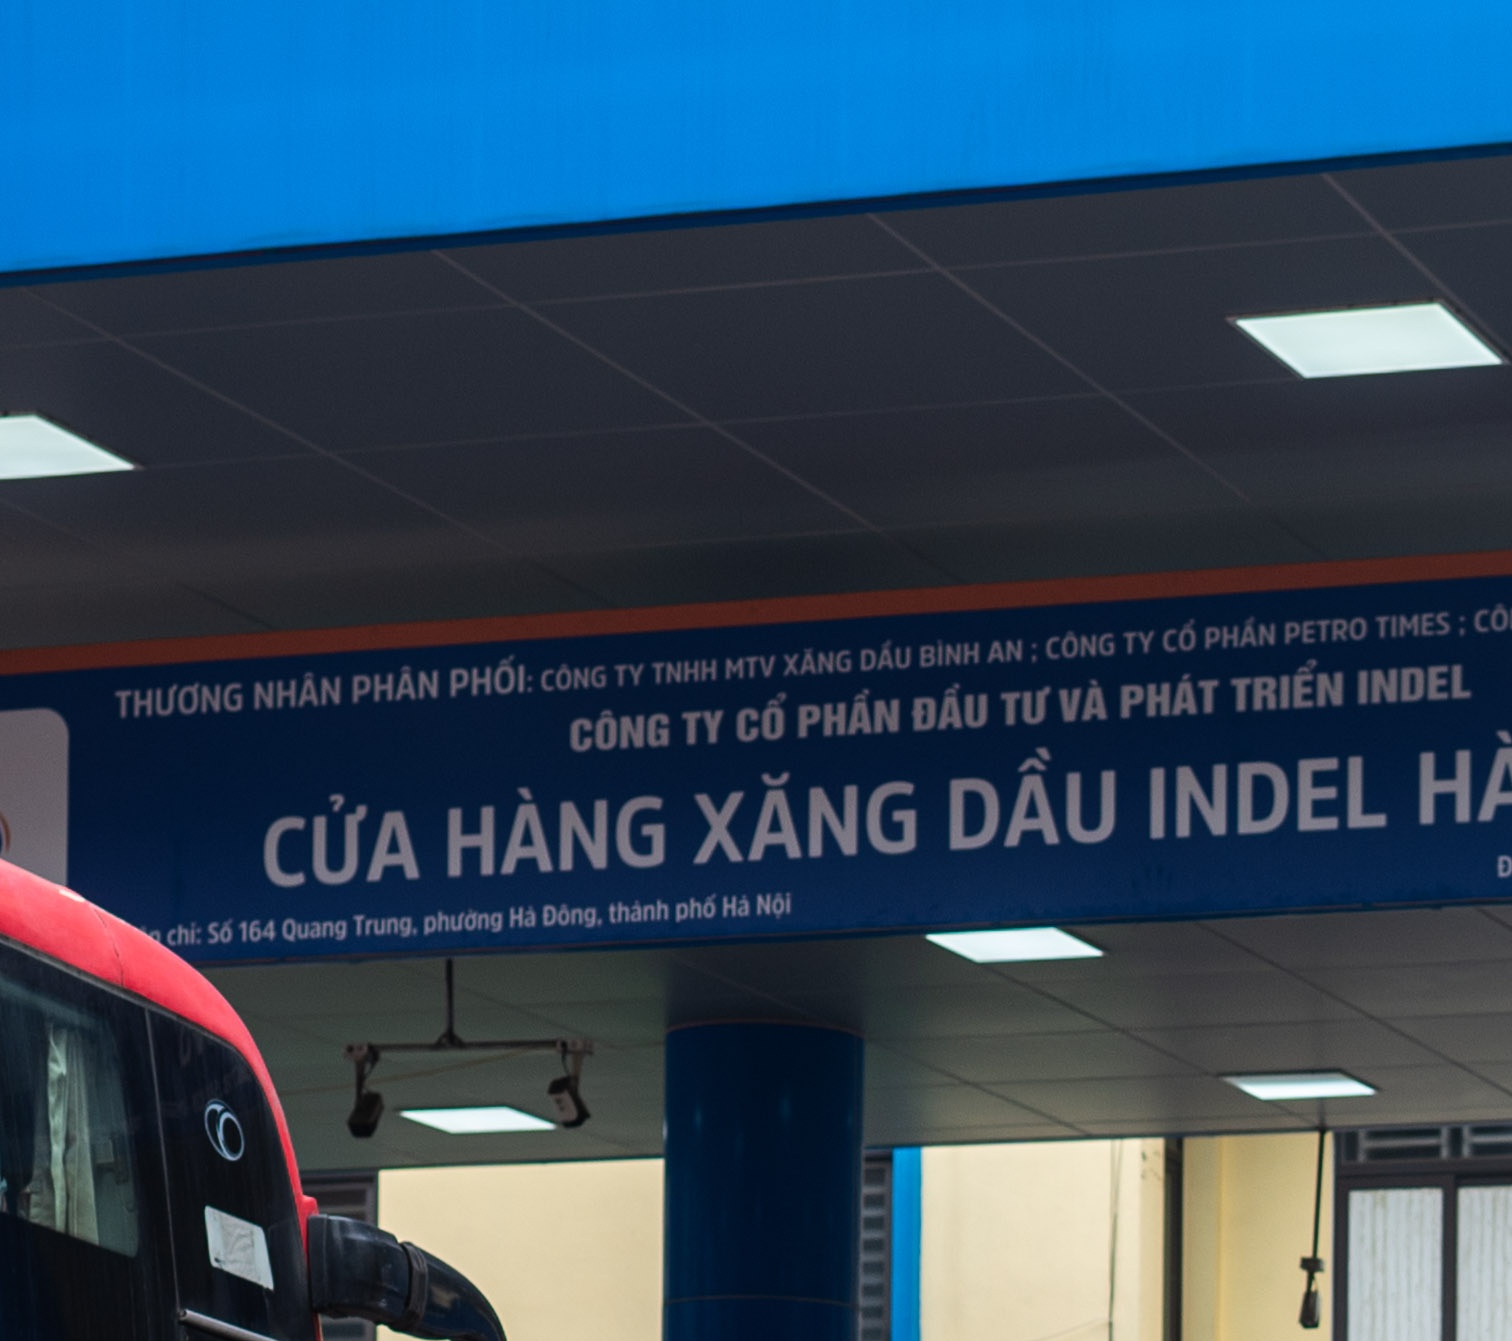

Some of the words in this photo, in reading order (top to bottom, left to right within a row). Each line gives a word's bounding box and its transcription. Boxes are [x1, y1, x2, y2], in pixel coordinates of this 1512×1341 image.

[115, 683, 243, 718] THƯƠNG
[254, 673, 341, 710] NHÂN
[352, 667, 439, 704] PHÂN
[450, 656, 532, 697] PHỐI:
[541, 664, 607, 691] CÔNG
[614, 664, 644, 687] TY
[652, 659, 717, 684] TNHH
[725, 655, 775, 680] MTV
[784, 649, 852, 676] XĂNG
[920, 639, 979, 668] BÌNH
[987, 640, 1023, 663] AN
[1046, 631, 1115, 659] CÔNG
[1123, 630, 1154, 654] TY
[1285, 617, 1368, 644] PETRO
[1376, 612, 1450, 638] TIMES
[570, 705, 670, 752] CÔNG
[682, 710, 724, 745] TY
[736, 692, 786, 742] CỔ
[798, 689, 900, 738] PHẦN
[912, 683, 988, 731] ĐẦU
[1000, 686, 1051, 726] TƯ
[1059, 679, 1108, 722] VÀ
[1120, 674, 1220, 719] PHÁT
[1230, 659, 1344, 712] TRIỂN
[1358, 664, 1472, 705] INDEL
[264, 794, 420, 888] CỬA
[447, 787, 665, 878] HÀNG
[693, 772, 917, 864] XĂNG
[949, 747, 1116, 850] DẦU
[1150, 755, 1387, 840] INDEL
[208, 918, 233, 944] Số
[239, 919, 276, 942] 164
[282, 918, 347, 941] Quang
[353, 914, 417, 938] Trung,
[424, 909, 503, 936] phường
[509, 905, 536, 928] Hà
[542, 903, 602, 928] Đông,
[608, 899, 669, 924] thành
[675, 893, 716, 922] phố
[723, 894, 750, 918] Hà
[756, 892, 791, 919] Nội
